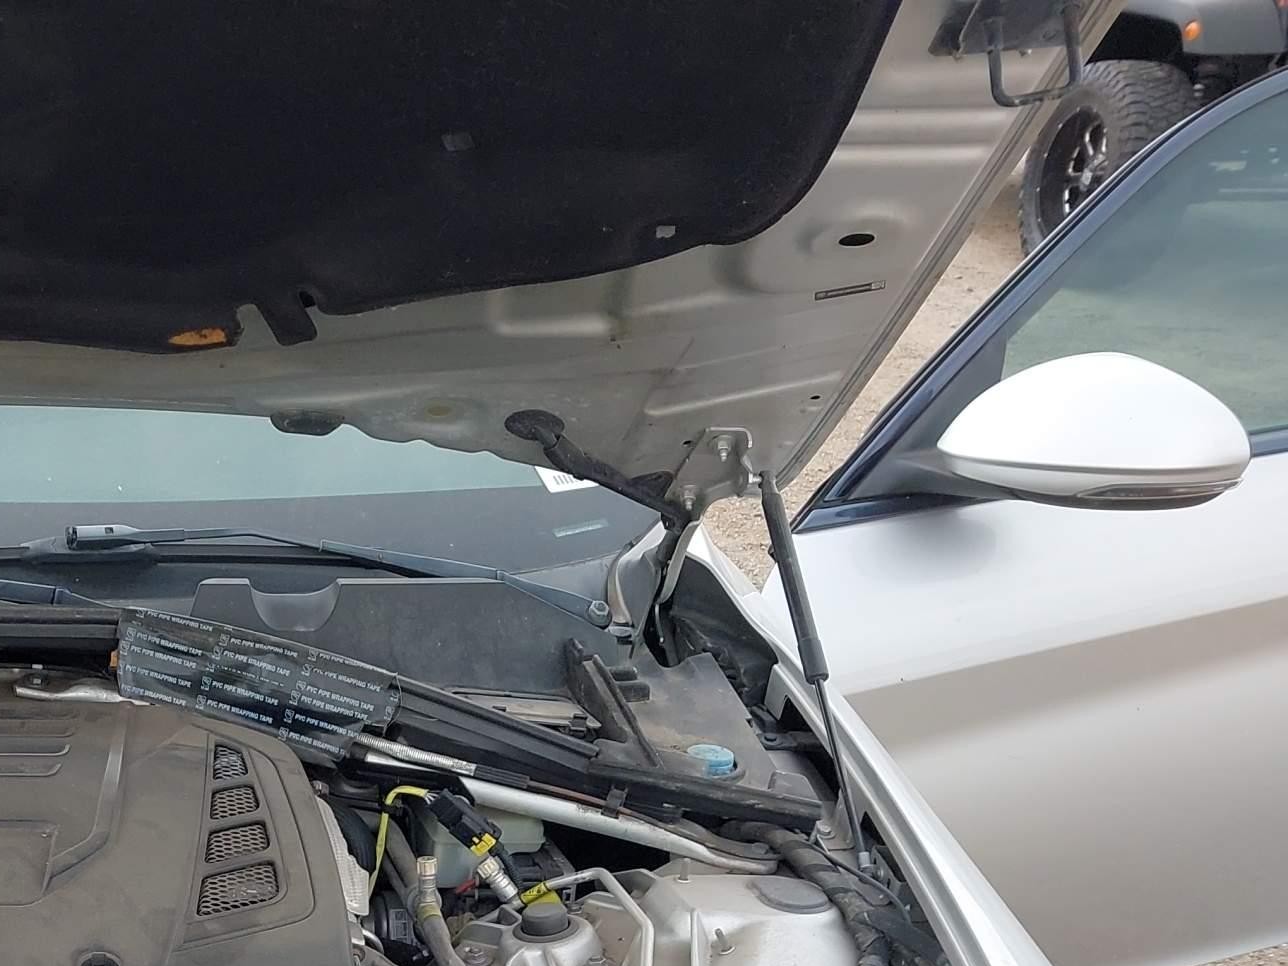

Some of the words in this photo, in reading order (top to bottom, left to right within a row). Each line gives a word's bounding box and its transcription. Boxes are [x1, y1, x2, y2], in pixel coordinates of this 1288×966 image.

[172, 616, 199, 628] WRAPPING
[137, 632, 147, 640] PVC
[148, 636, 160, 644] PIPE
[161, 639, 188, 652] WRAPPING
[189, 648, 202, 656] TAPE
[255, 643, 283, 653] WRAPPING
[155, 652, 182, 665] WRAPPING
[235, 654, 247, 662] PIPE
[248, 658, 275, 672] WRAPPING
[276, 667, 290, 676] TAPE
[150, 672, 177, 684] WRAPPING
[178, 680, 192, 688] TAPE
[338, 674, 366, 688] WRAPPING
[367, 684, 380, 692] TAPE
[132, 687, 144, 695] PIPE
[145, 690, 172, 702] WRAPPING
[224, 684, 236, 692] PIPE
[237, 687, 264, 701] WRAPPING
[265, 696, 278, 705] TAPE
[307, 685, 318, 693] PVC
[318, 689, 330, 698] PIPE
[331, 693, 359, 706] WRAPPING
[361, 702, 374, 711] TAPE
[218, 703, 230, 711] PIPE
[231, 706, 259, 720] WRAPPING
[259, 715, 273, 724] TAPE
[301, 695, 312, 703] PVC
[312, 700, 324, 708] PIPE
[325, 703, 354, 716] WRAPPING
[355, 712, 368, 720] TAPE
[306, 718, 319, 726] PIPE
[319, 721, 347, 734] WRAPPING
[289, 732, 299, 740] PVC
[300, 735, 312, 744] PIPE
[313, 739, 341, 752] WRAPPING
